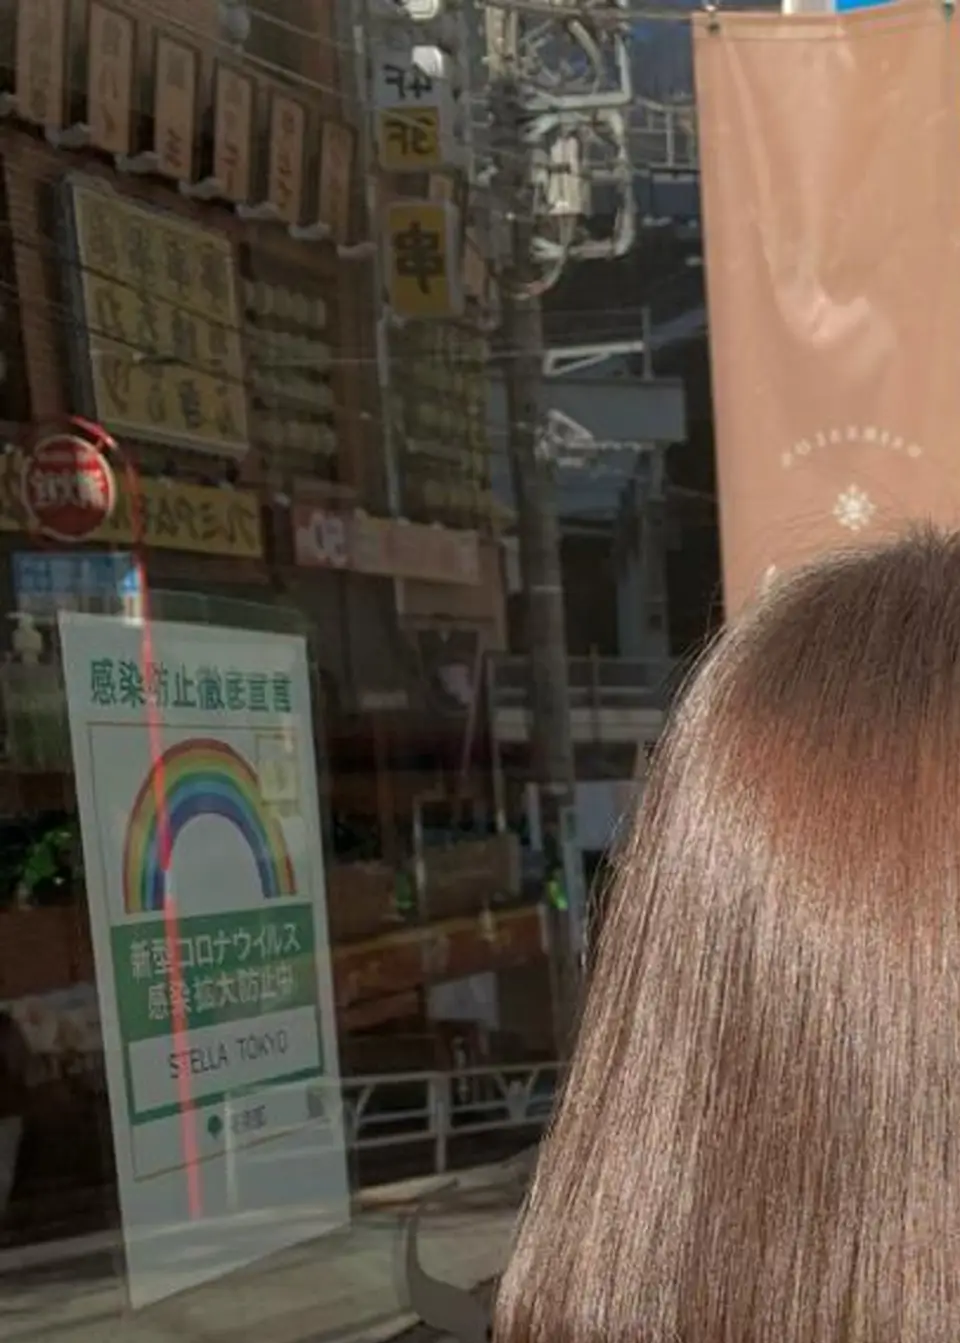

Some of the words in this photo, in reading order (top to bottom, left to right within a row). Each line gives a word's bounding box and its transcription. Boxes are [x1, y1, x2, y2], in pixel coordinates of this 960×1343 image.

[129, 922, 303, 985] 新型コロナウイルス
